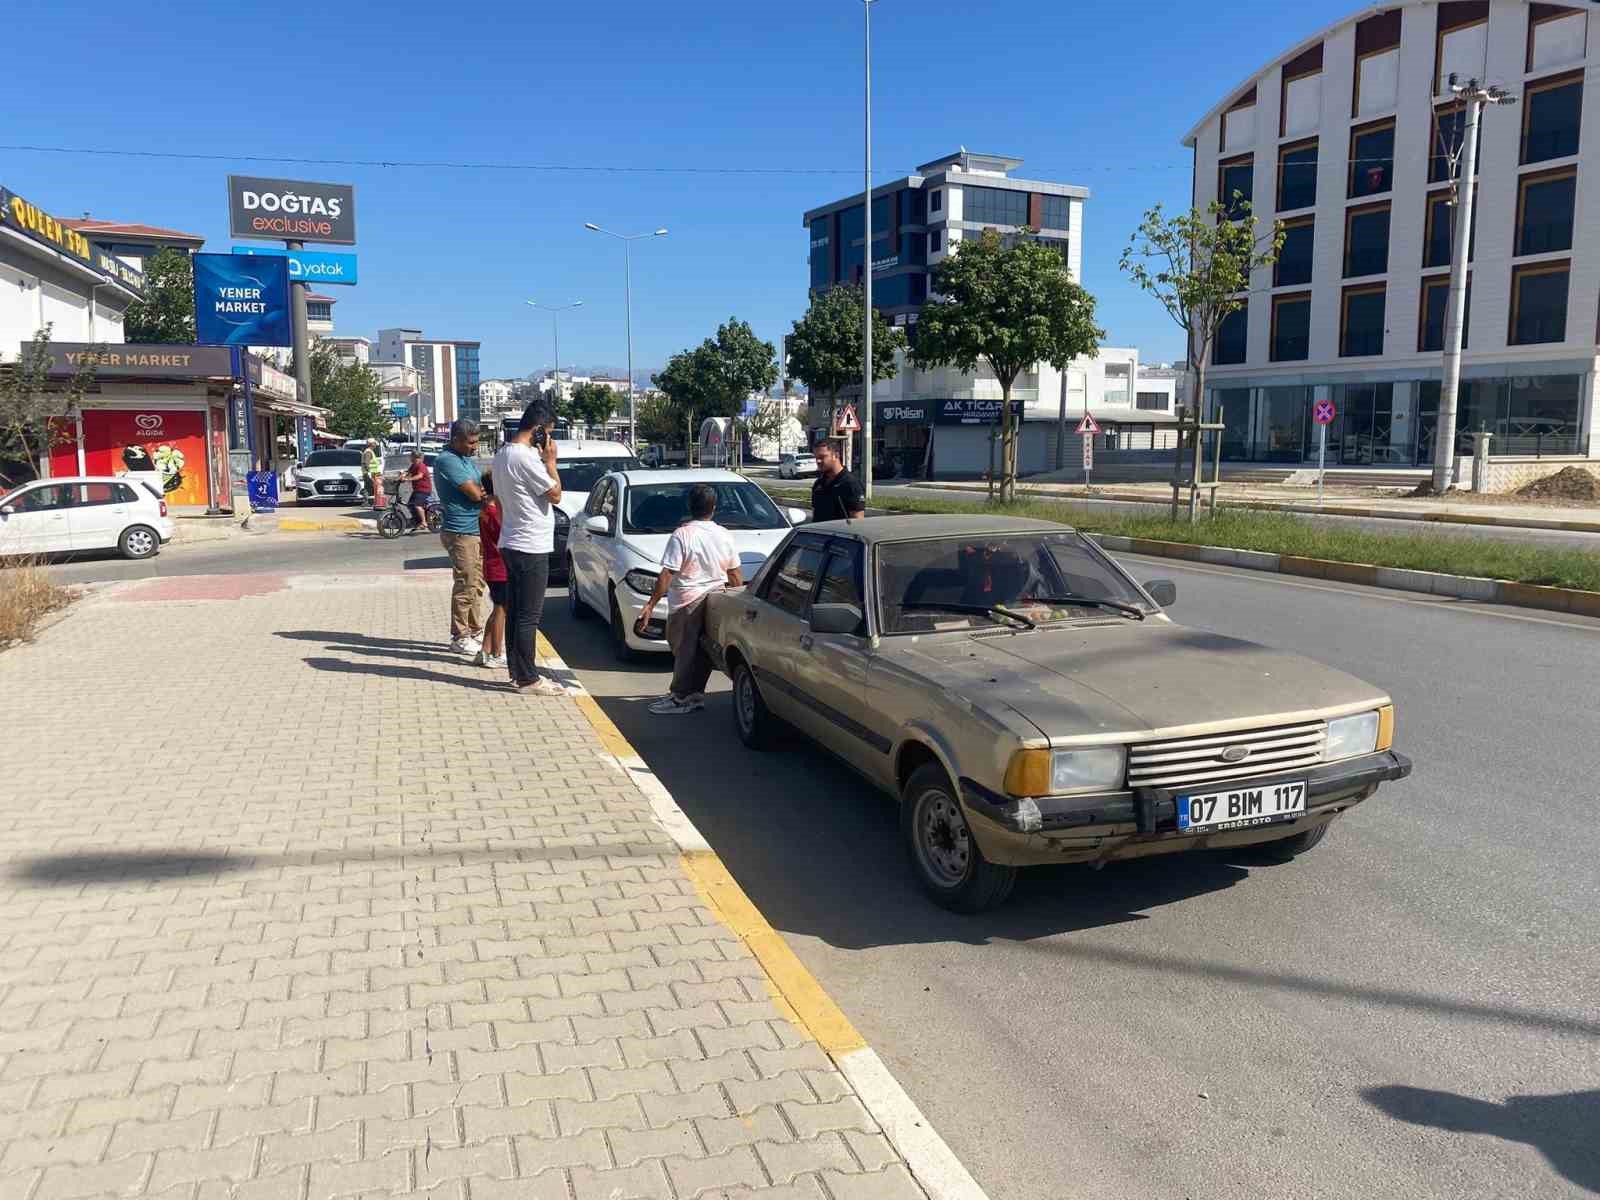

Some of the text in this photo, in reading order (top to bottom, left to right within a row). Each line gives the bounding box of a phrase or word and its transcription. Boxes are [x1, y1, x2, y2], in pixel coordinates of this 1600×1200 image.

[242, 191, 342, 219] DOĞTAŞ
[252, 216, 332, 235] exclusive
[303, 262, 344, 277] yatak
[219, 287, 261, 299] YENER
[215, 302, 267, 313] MARKET
[126, 354, 192, 367] MARKET
[944, 400, 1019, 410] AK TİCART
[895, 407, 923, 419] Polisan
[1190, 784, 1304, 823] 07 BIM 117
[1252, 816, 1272, 825] OTO
